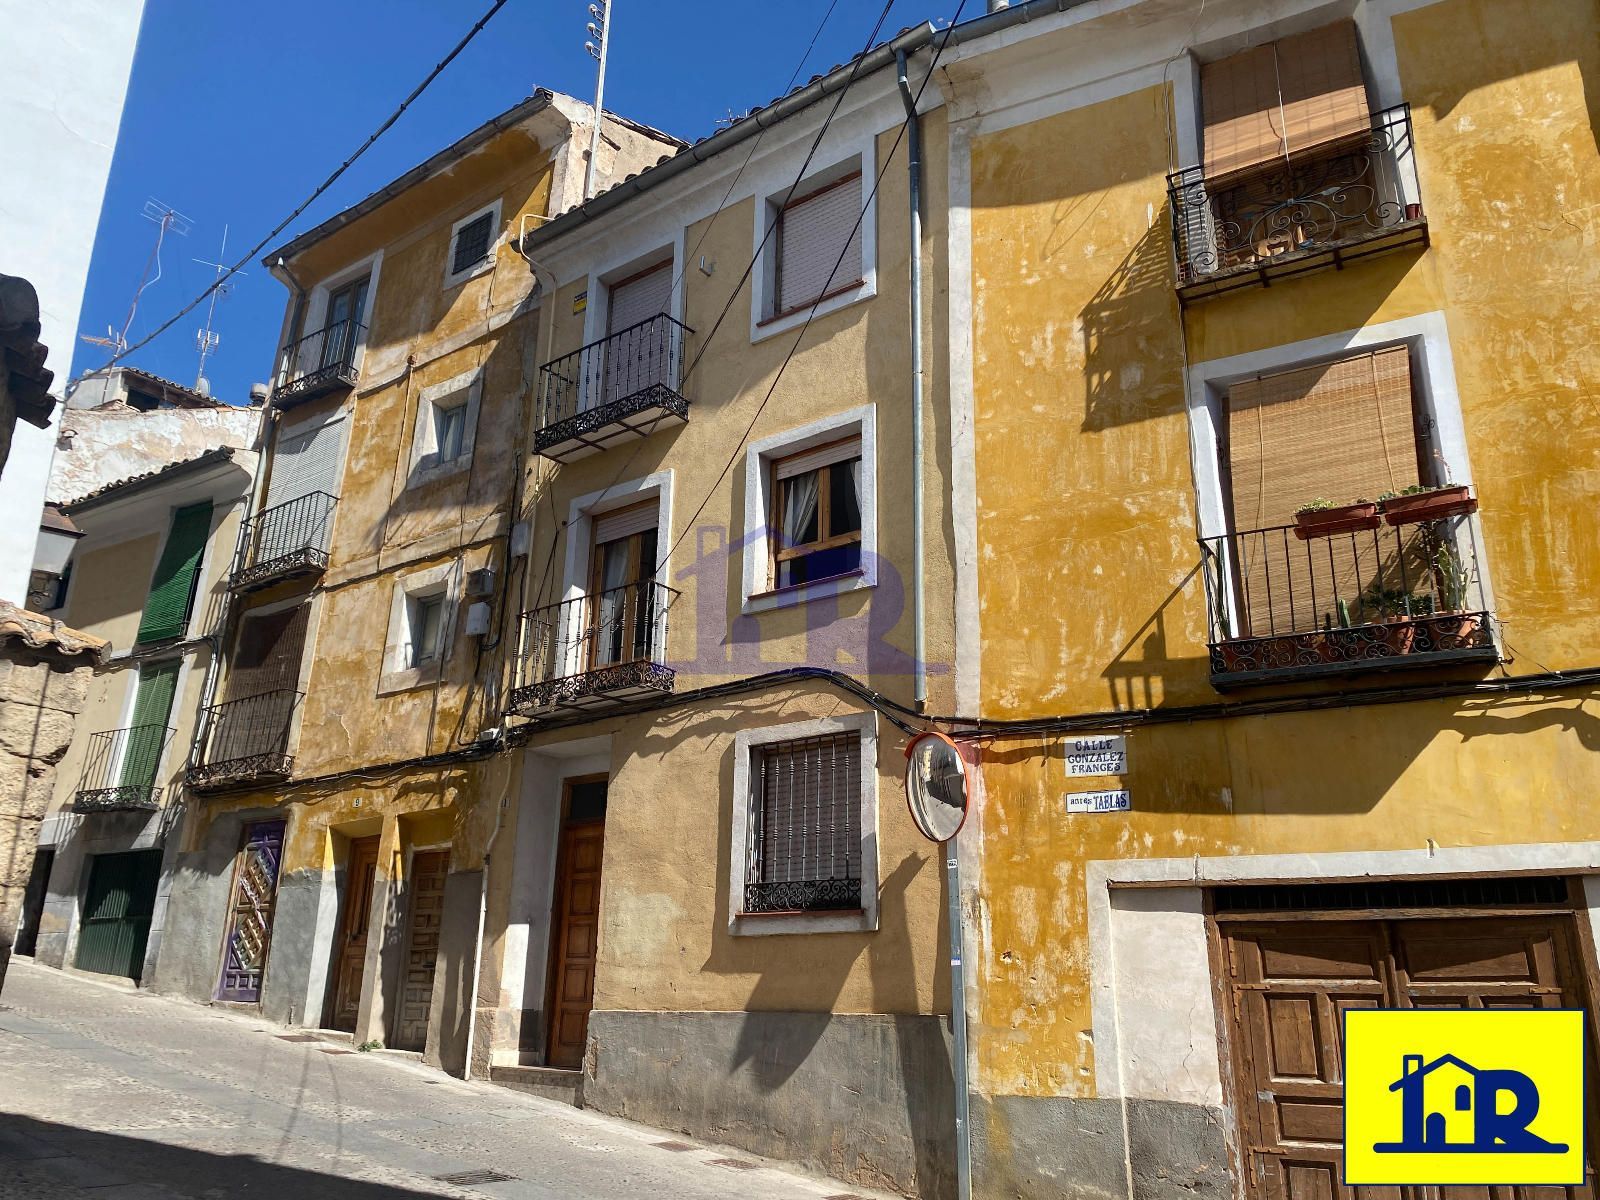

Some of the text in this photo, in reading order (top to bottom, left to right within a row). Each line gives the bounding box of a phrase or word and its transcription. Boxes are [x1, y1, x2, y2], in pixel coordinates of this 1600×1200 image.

[1075, 740, 1112, 751] CALLE
[1067, 751, 1123, 763] GONZALEZ
[1093, 793, 1126, 810] TABLAS
